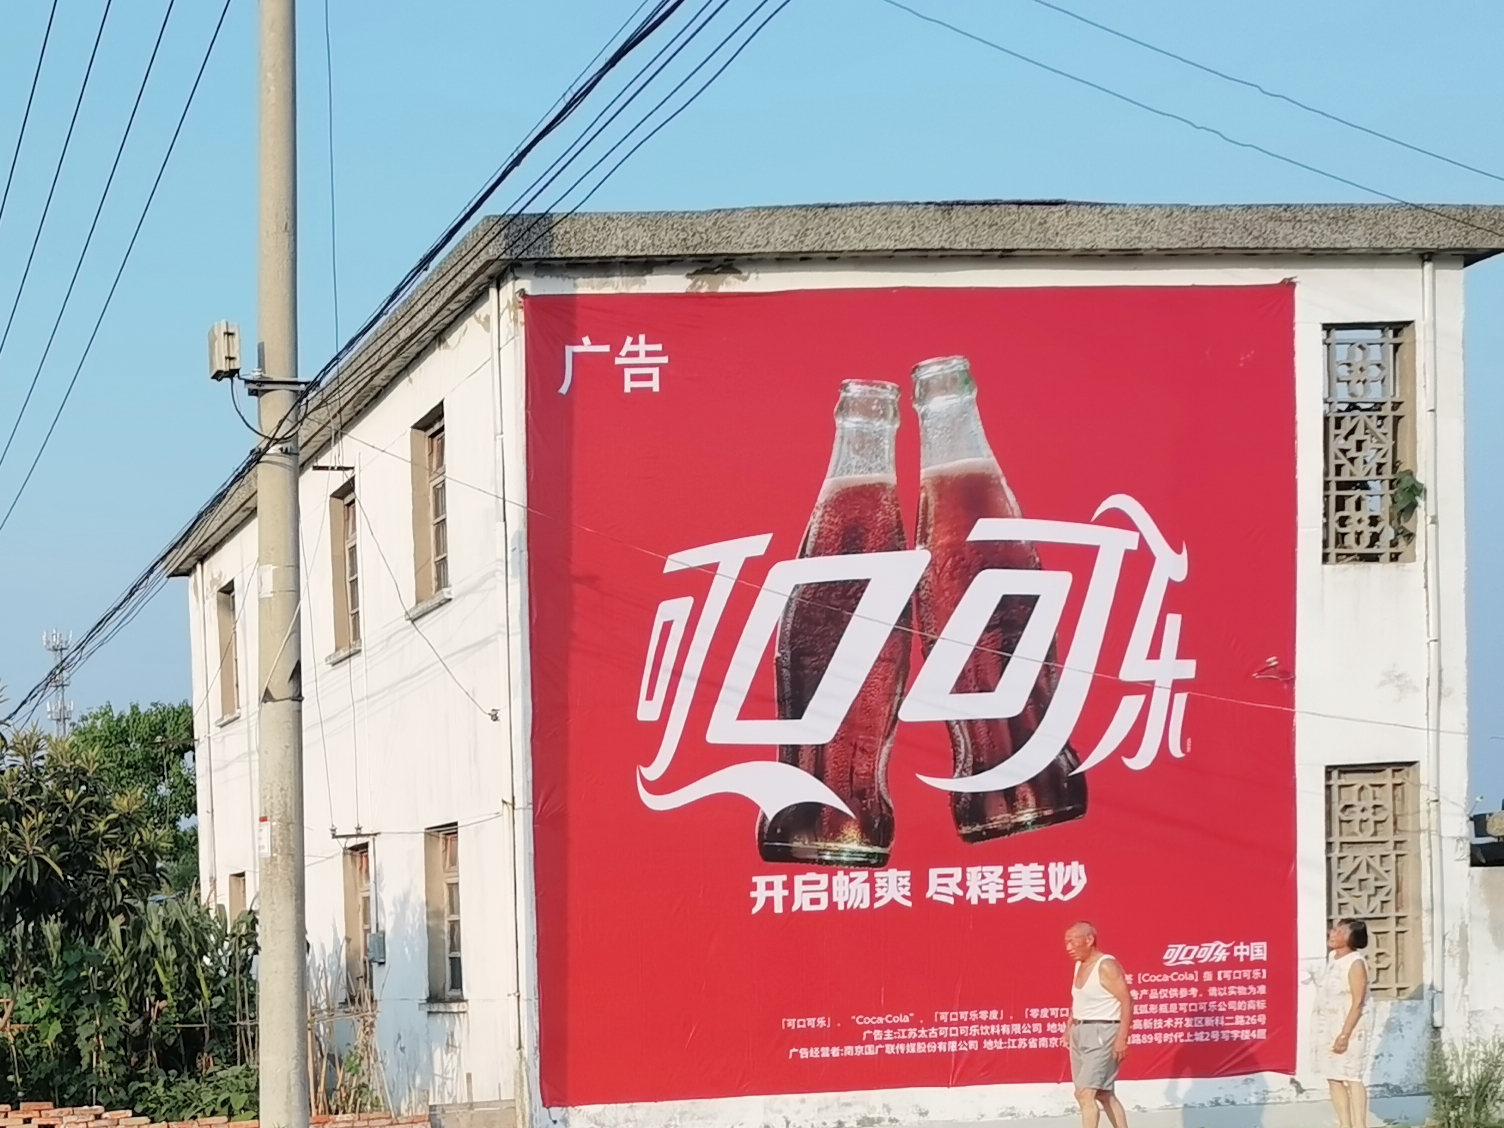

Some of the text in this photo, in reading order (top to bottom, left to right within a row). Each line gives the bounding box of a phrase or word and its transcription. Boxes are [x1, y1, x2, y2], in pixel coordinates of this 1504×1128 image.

[559, 334, 669, 395] 广告
[637, 494, 1196, 820] 可口可乐
[749, 861, 1088, 915] 开启畅爽 尽释美妙
[1162, 941, 1268, 967] 可口可乐 中国
